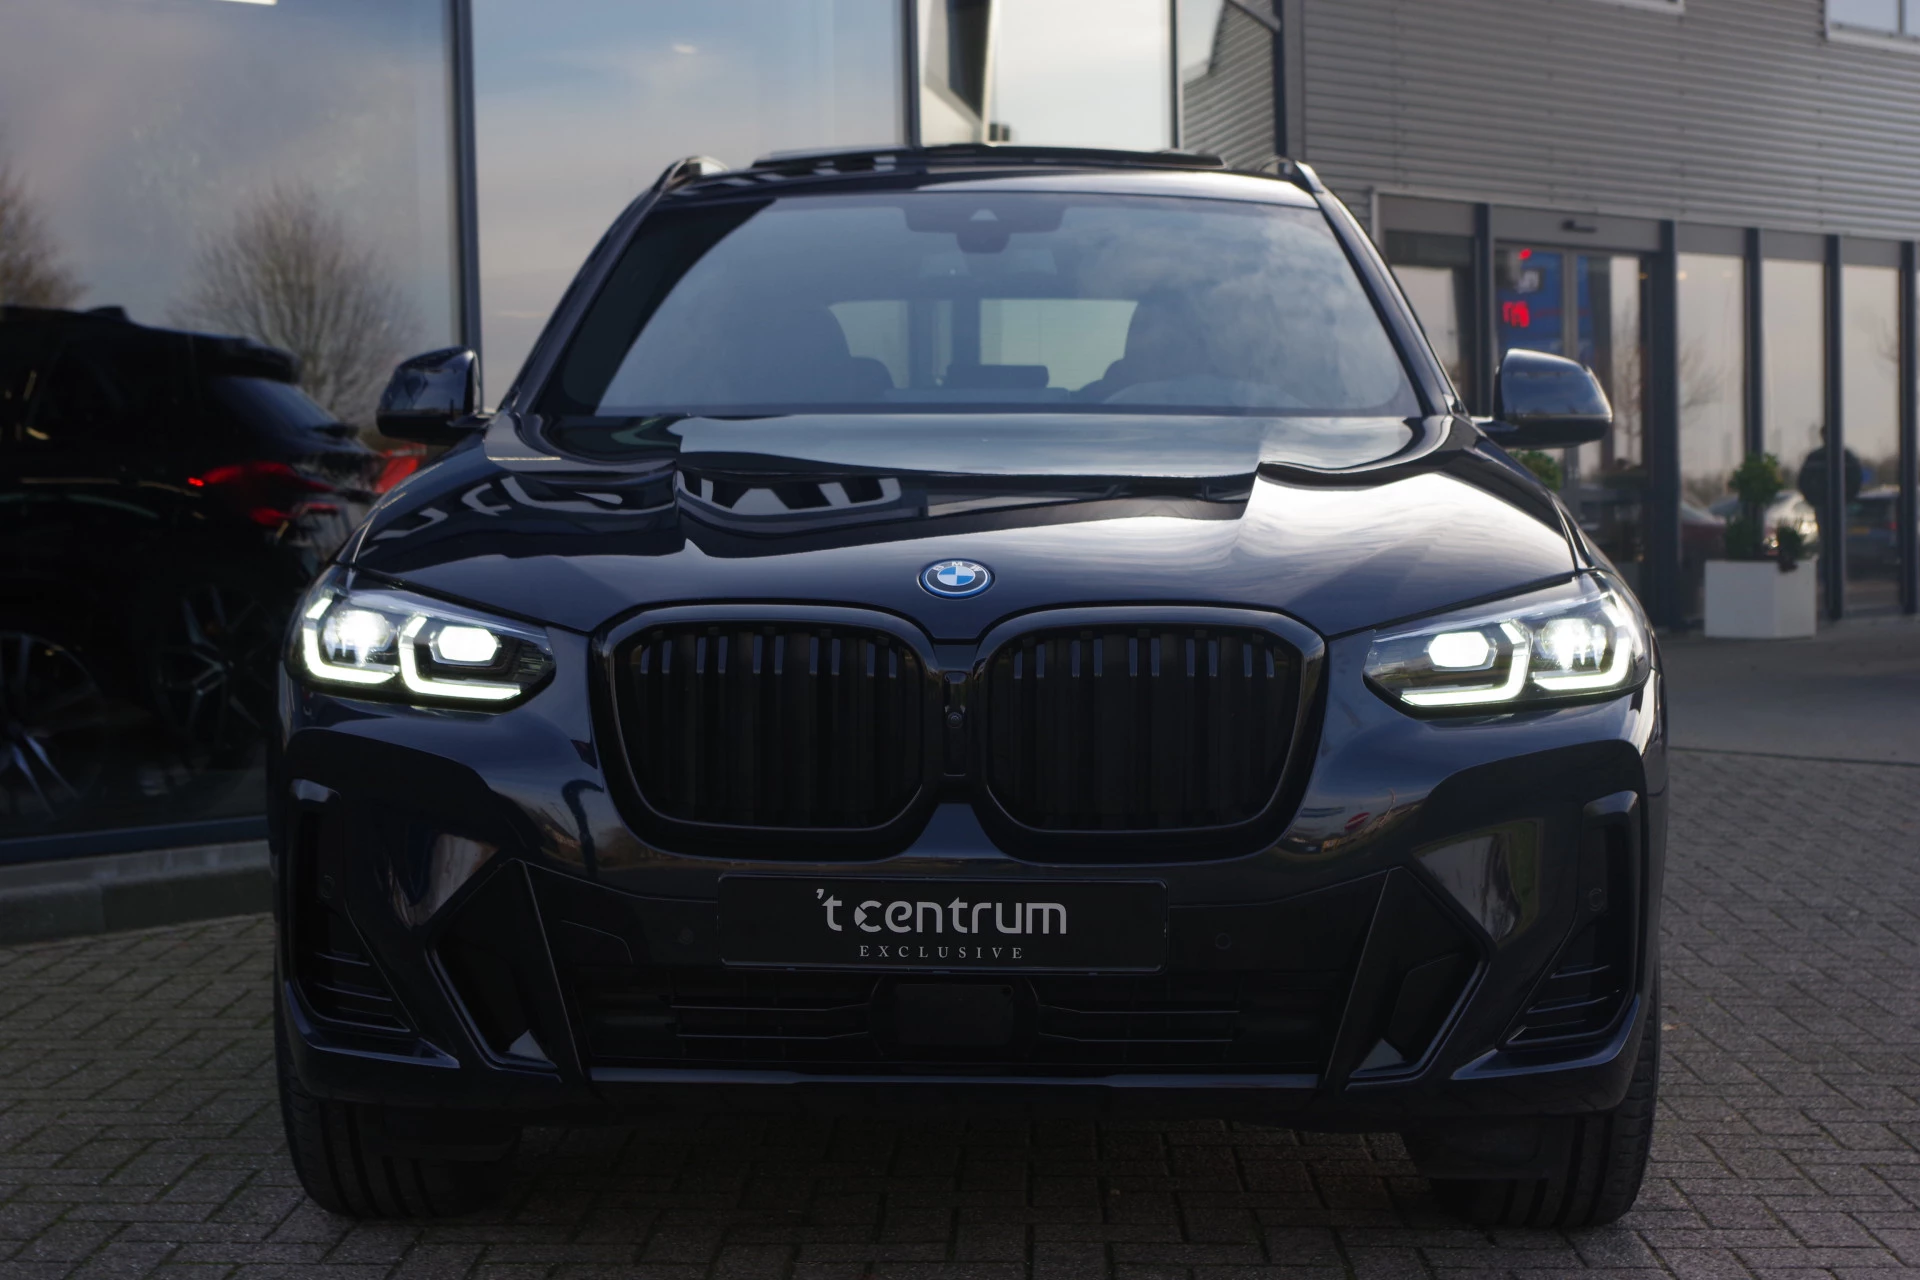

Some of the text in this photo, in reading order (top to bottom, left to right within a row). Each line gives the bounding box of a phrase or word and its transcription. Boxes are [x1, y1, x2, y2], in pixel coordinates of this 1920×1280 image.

[932, 561, 984, 572] BMW
[854, 897, 1067, 935] centrum
[859, 945, 1022, 960] EXCLUSIVE
